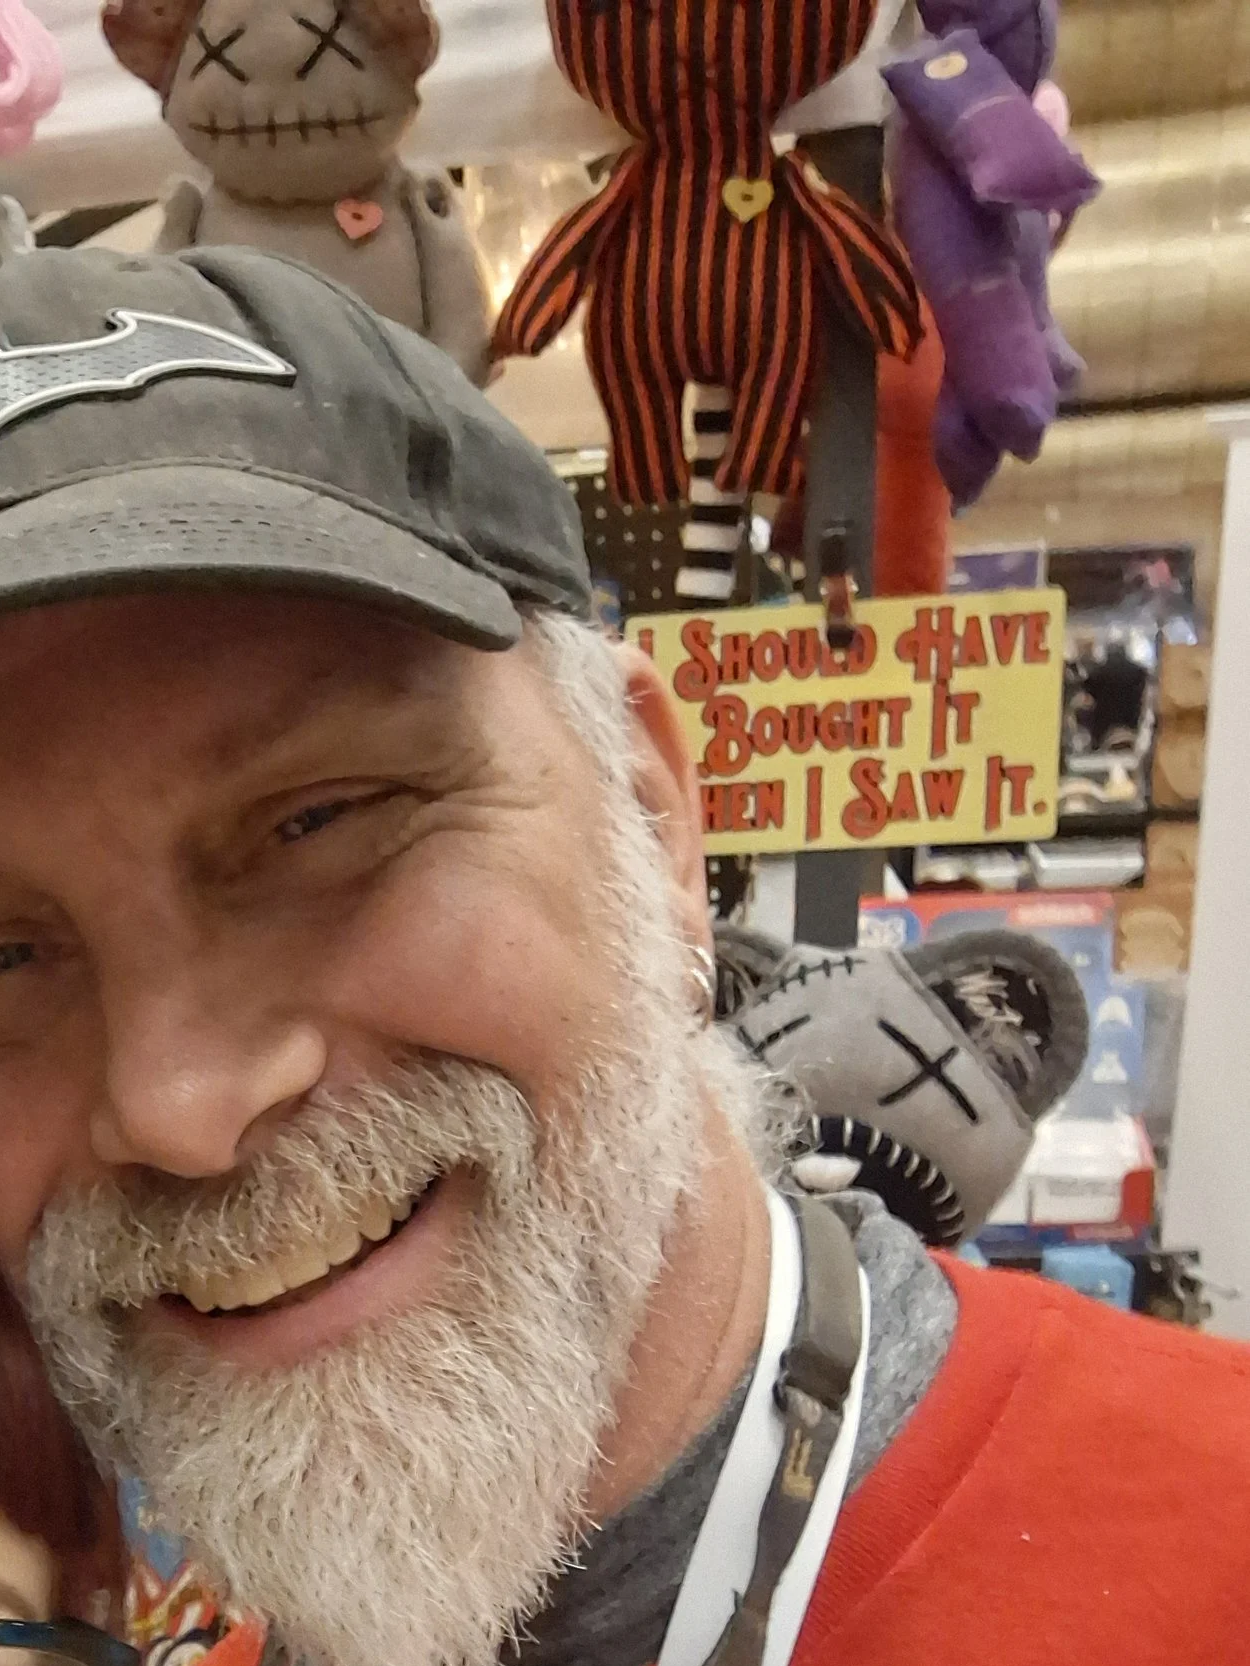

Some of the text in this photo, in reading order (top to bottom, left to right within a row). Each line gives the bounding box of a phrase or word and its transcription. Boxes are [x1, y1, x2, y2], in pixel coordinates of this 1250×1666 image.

[895, 606, 1049, 682] HAVE
[697, 679, 981, 779] BOUGHT IT
[699, 756, 1048, 842] HEN I SAW IT.
